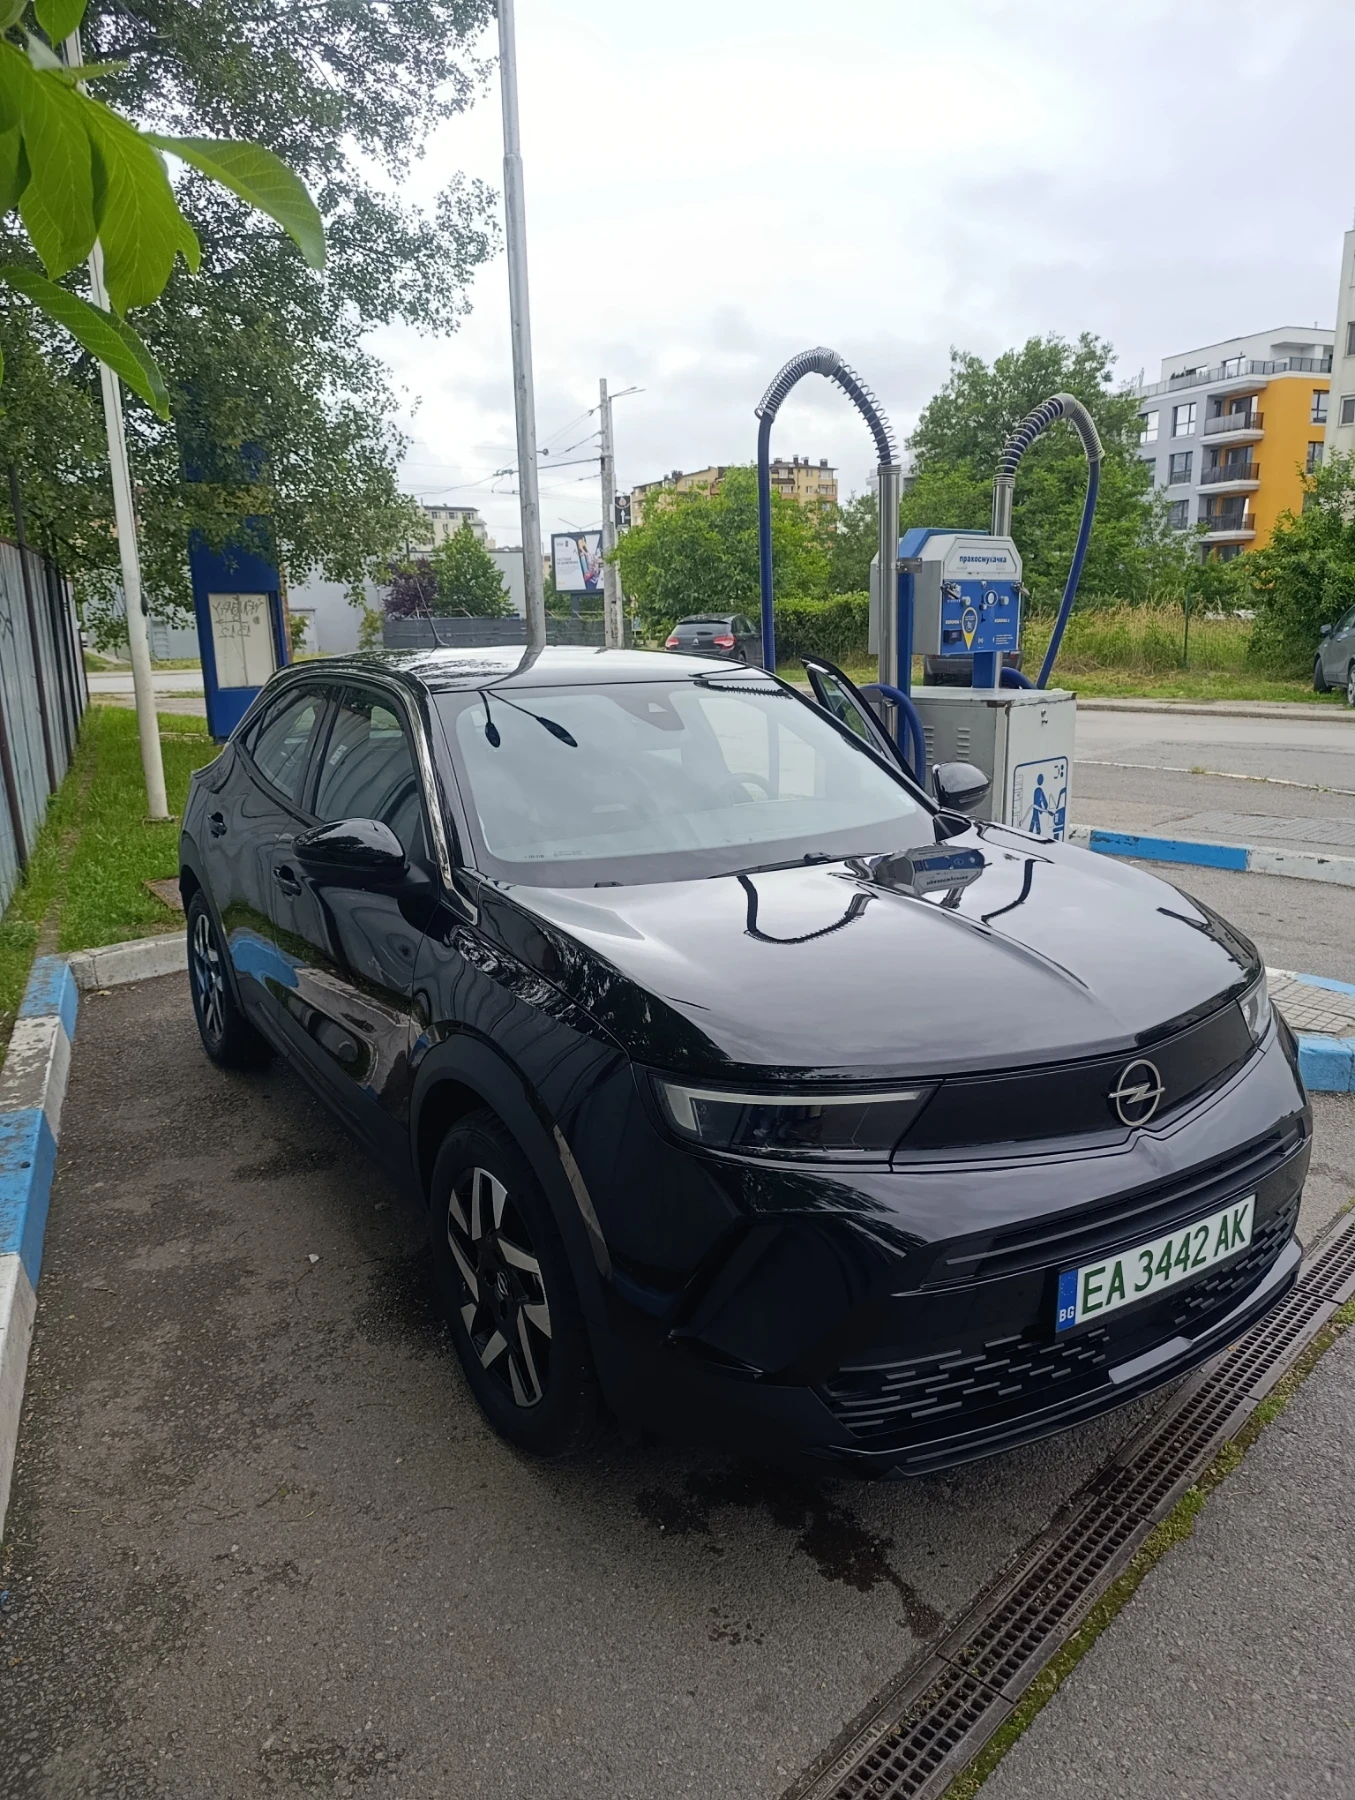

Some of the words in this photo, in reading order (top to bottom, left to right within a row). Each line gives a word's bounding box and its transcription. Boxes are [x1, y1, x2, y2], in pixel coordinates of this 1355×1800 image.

[1081, 1260, 1126, 1315] EA
[1134, 1224, 1210, 1293] 3442
[1213, 1203, 1249, 1258] AK
[1058, 1305, 1075, 1323] BG
